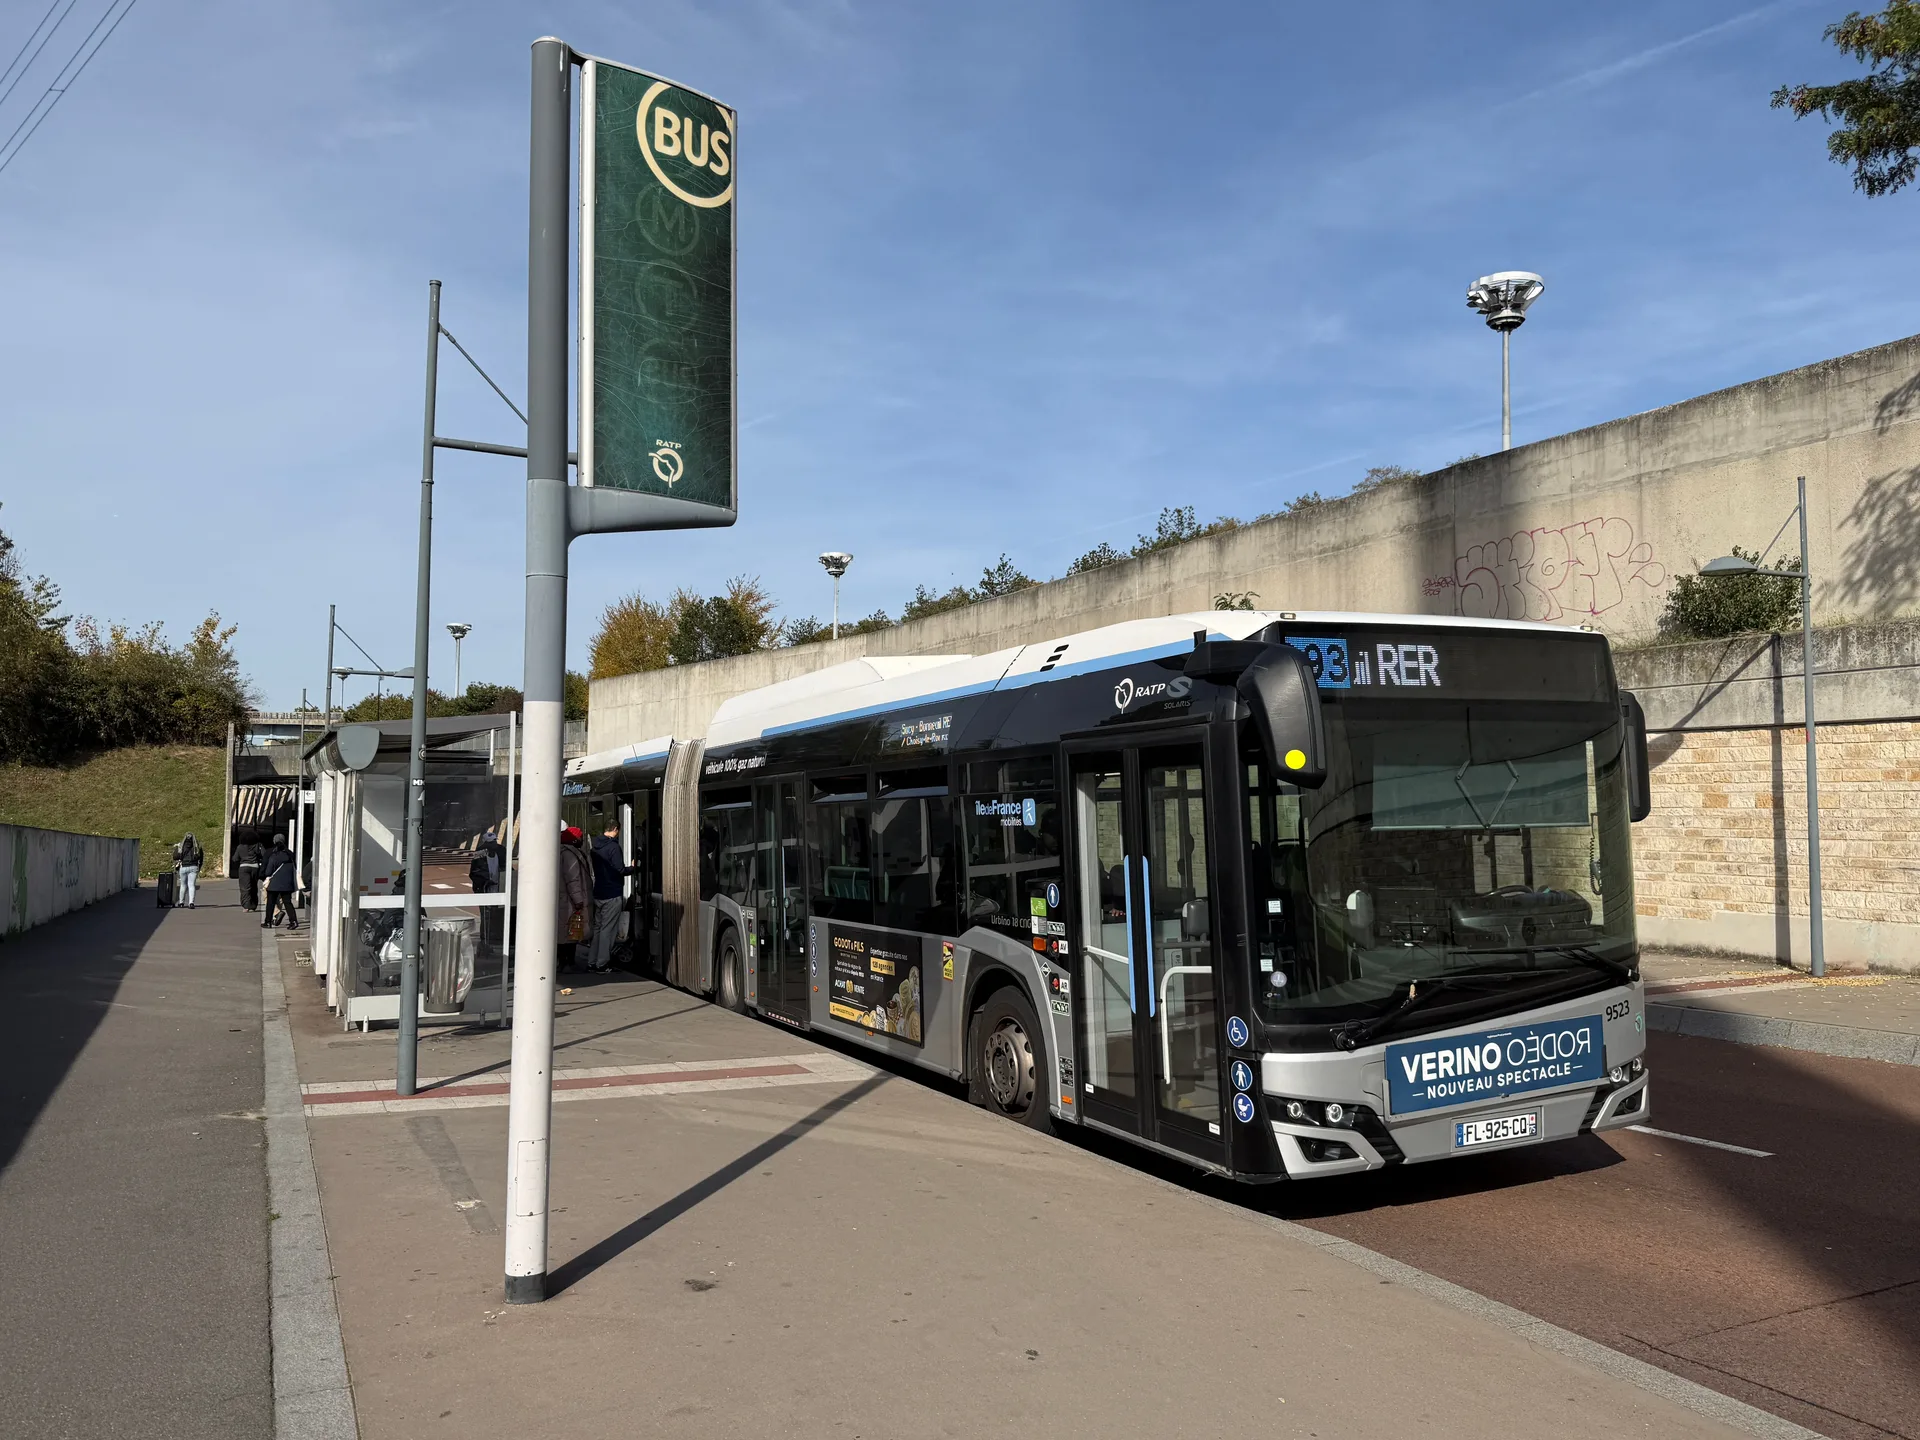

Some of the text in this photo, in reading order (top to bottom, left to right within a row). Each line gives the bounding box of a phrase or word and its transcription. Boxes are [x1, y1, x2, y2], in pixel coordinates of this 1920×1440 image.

[654, 106, 730, 176] BUS
[656, 439, 682, 449] RATP
[1304, 643, 1442, 686] 93 RER
[1135, 683, 1166, 697] RATP
[1164, 700, 1191, 710] SOLARIS
[737, 758, 748, 773] gaz
[747, 753, 768, 769] naturel
[1011, 917, 1019, 927] 18
[1606, 999, 1630, 1022] 9523
[1401, 1042, 1501, 1084] VERINO
[1427, 1062, 1571, 1099] NOUVEAU SPECTACLE
[1529, 1124, 1536, 1134] 75
